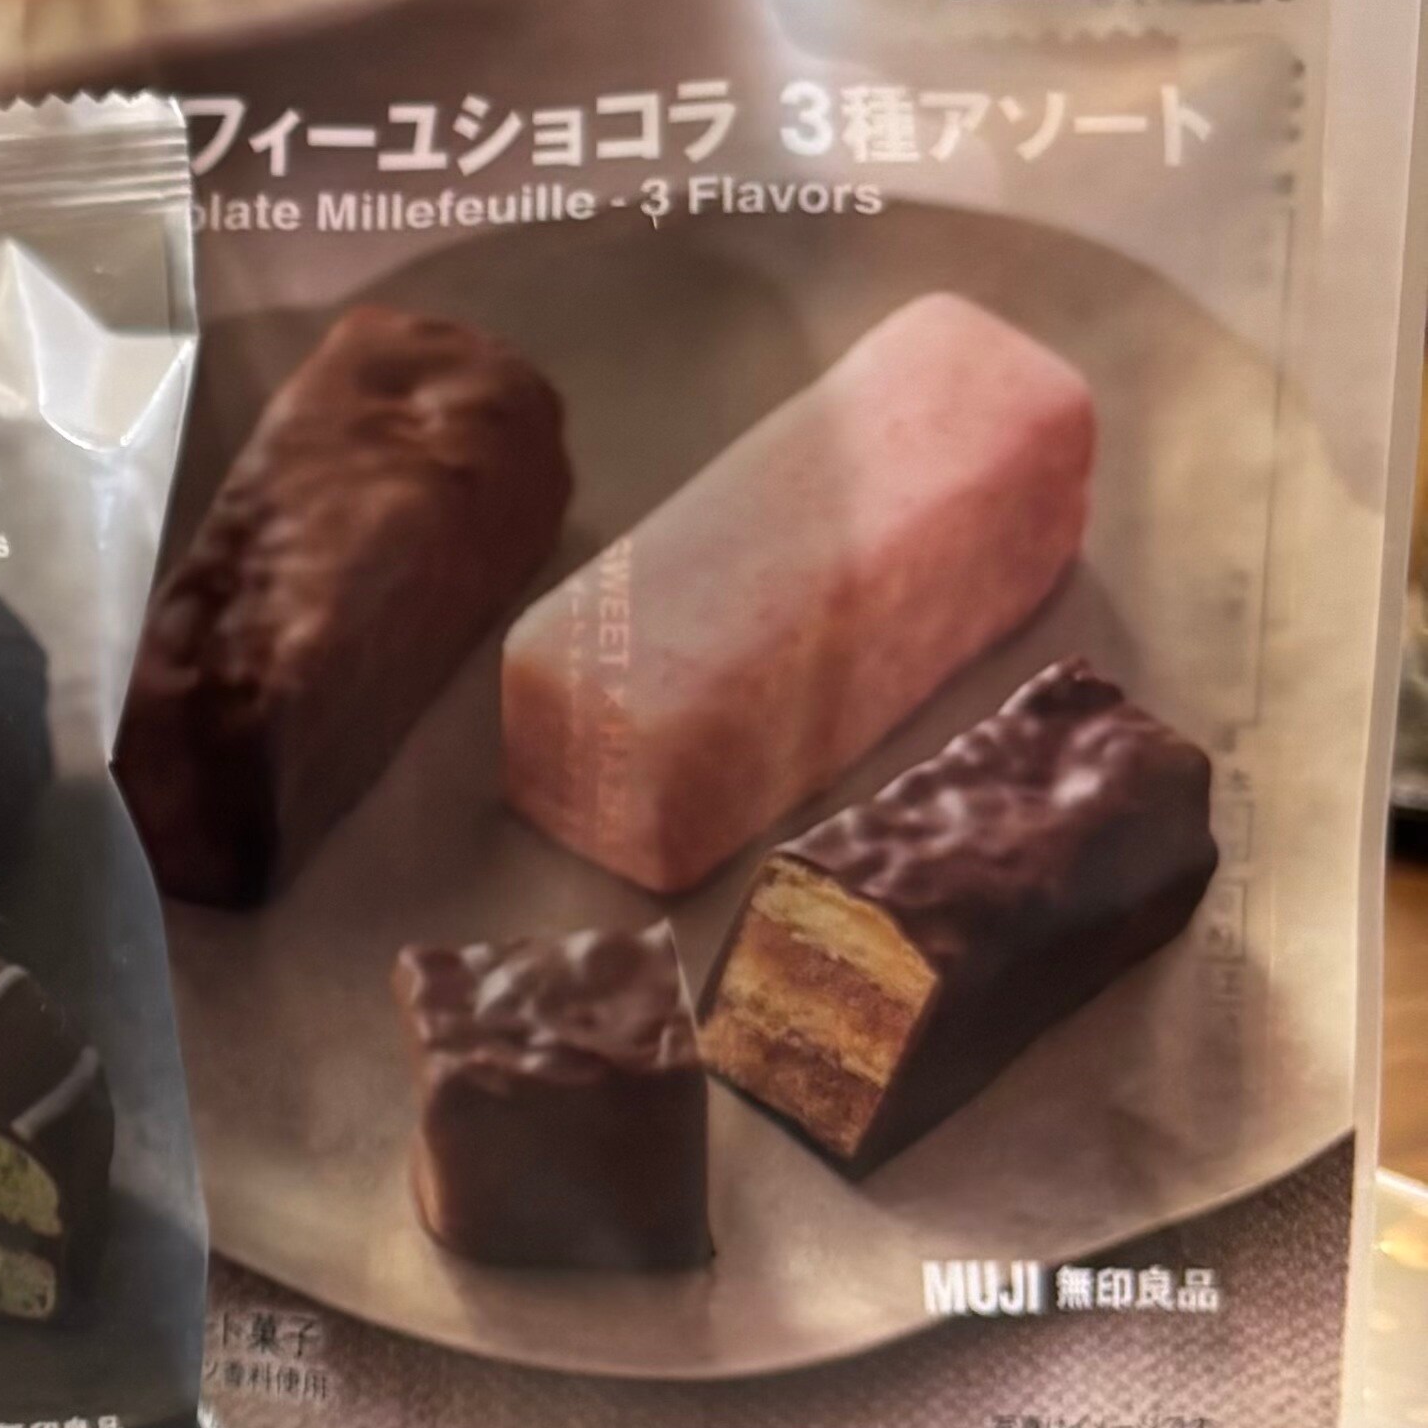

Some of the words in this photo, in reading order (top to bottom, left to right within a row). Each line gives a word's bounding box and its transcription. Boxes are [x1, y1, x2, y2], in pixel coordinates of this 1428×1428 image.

[182, 80, 737, 177] フィーユショコラ
[780, 79, 1214, 167] 3種アソート
[318, 183, 595, 232] Millefeuille
[640, 177, 669, 217] 3
[689, 175, 882, 215] Flavors
[923, 1260, 1040, 1315] MUJI
[1056, 1265, 1220, 1313] 無印良品
